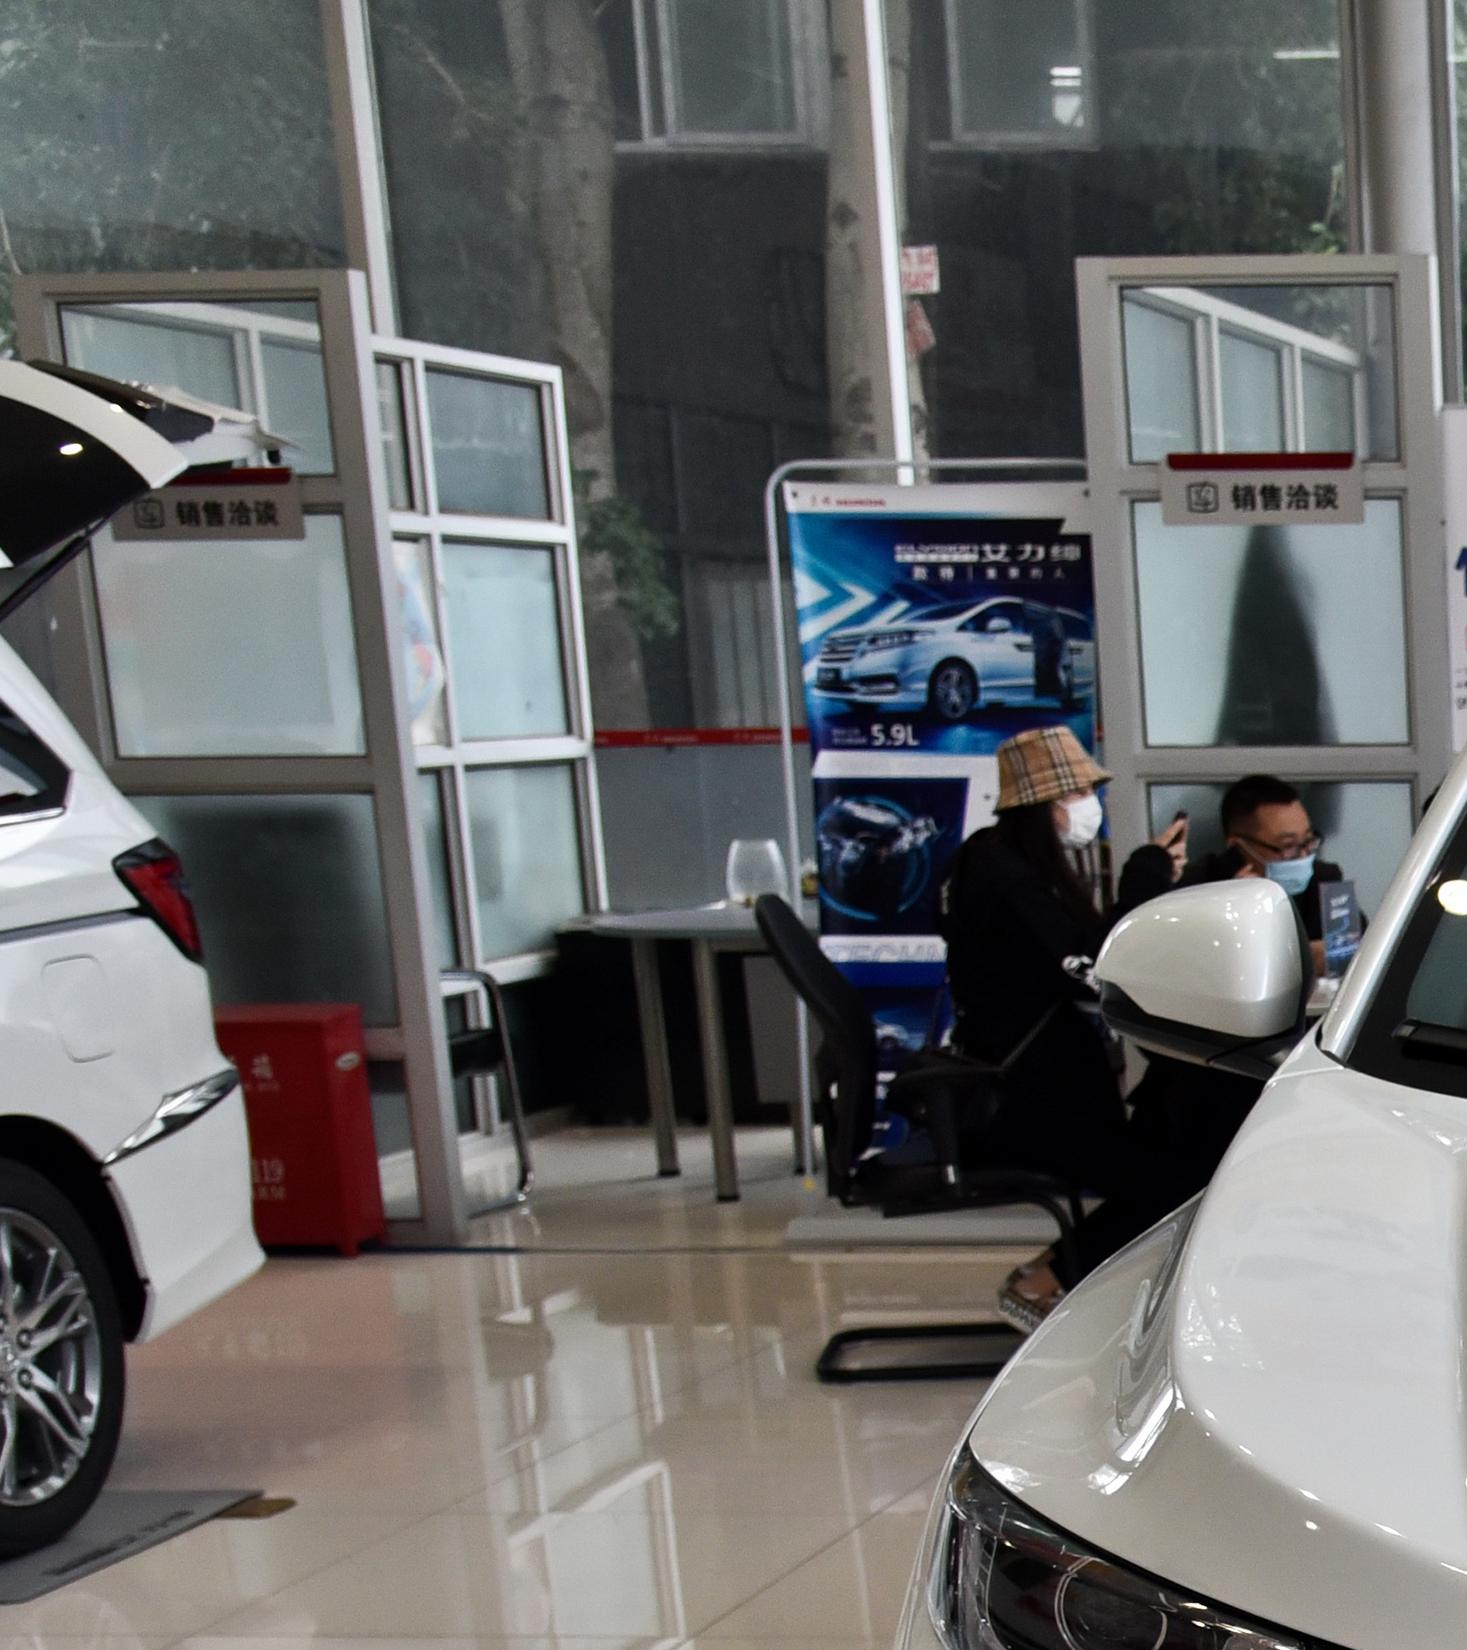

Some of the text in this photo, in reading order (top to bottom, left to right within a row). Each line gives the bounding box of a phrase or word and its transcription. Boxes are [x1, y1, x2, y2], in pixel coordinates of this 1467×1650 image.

[1232, 483, 1339, 512] 销售洽谈
[176, 499, 279, 527] 销售洽谈
[870, 723, 920, 747] 5.9L
